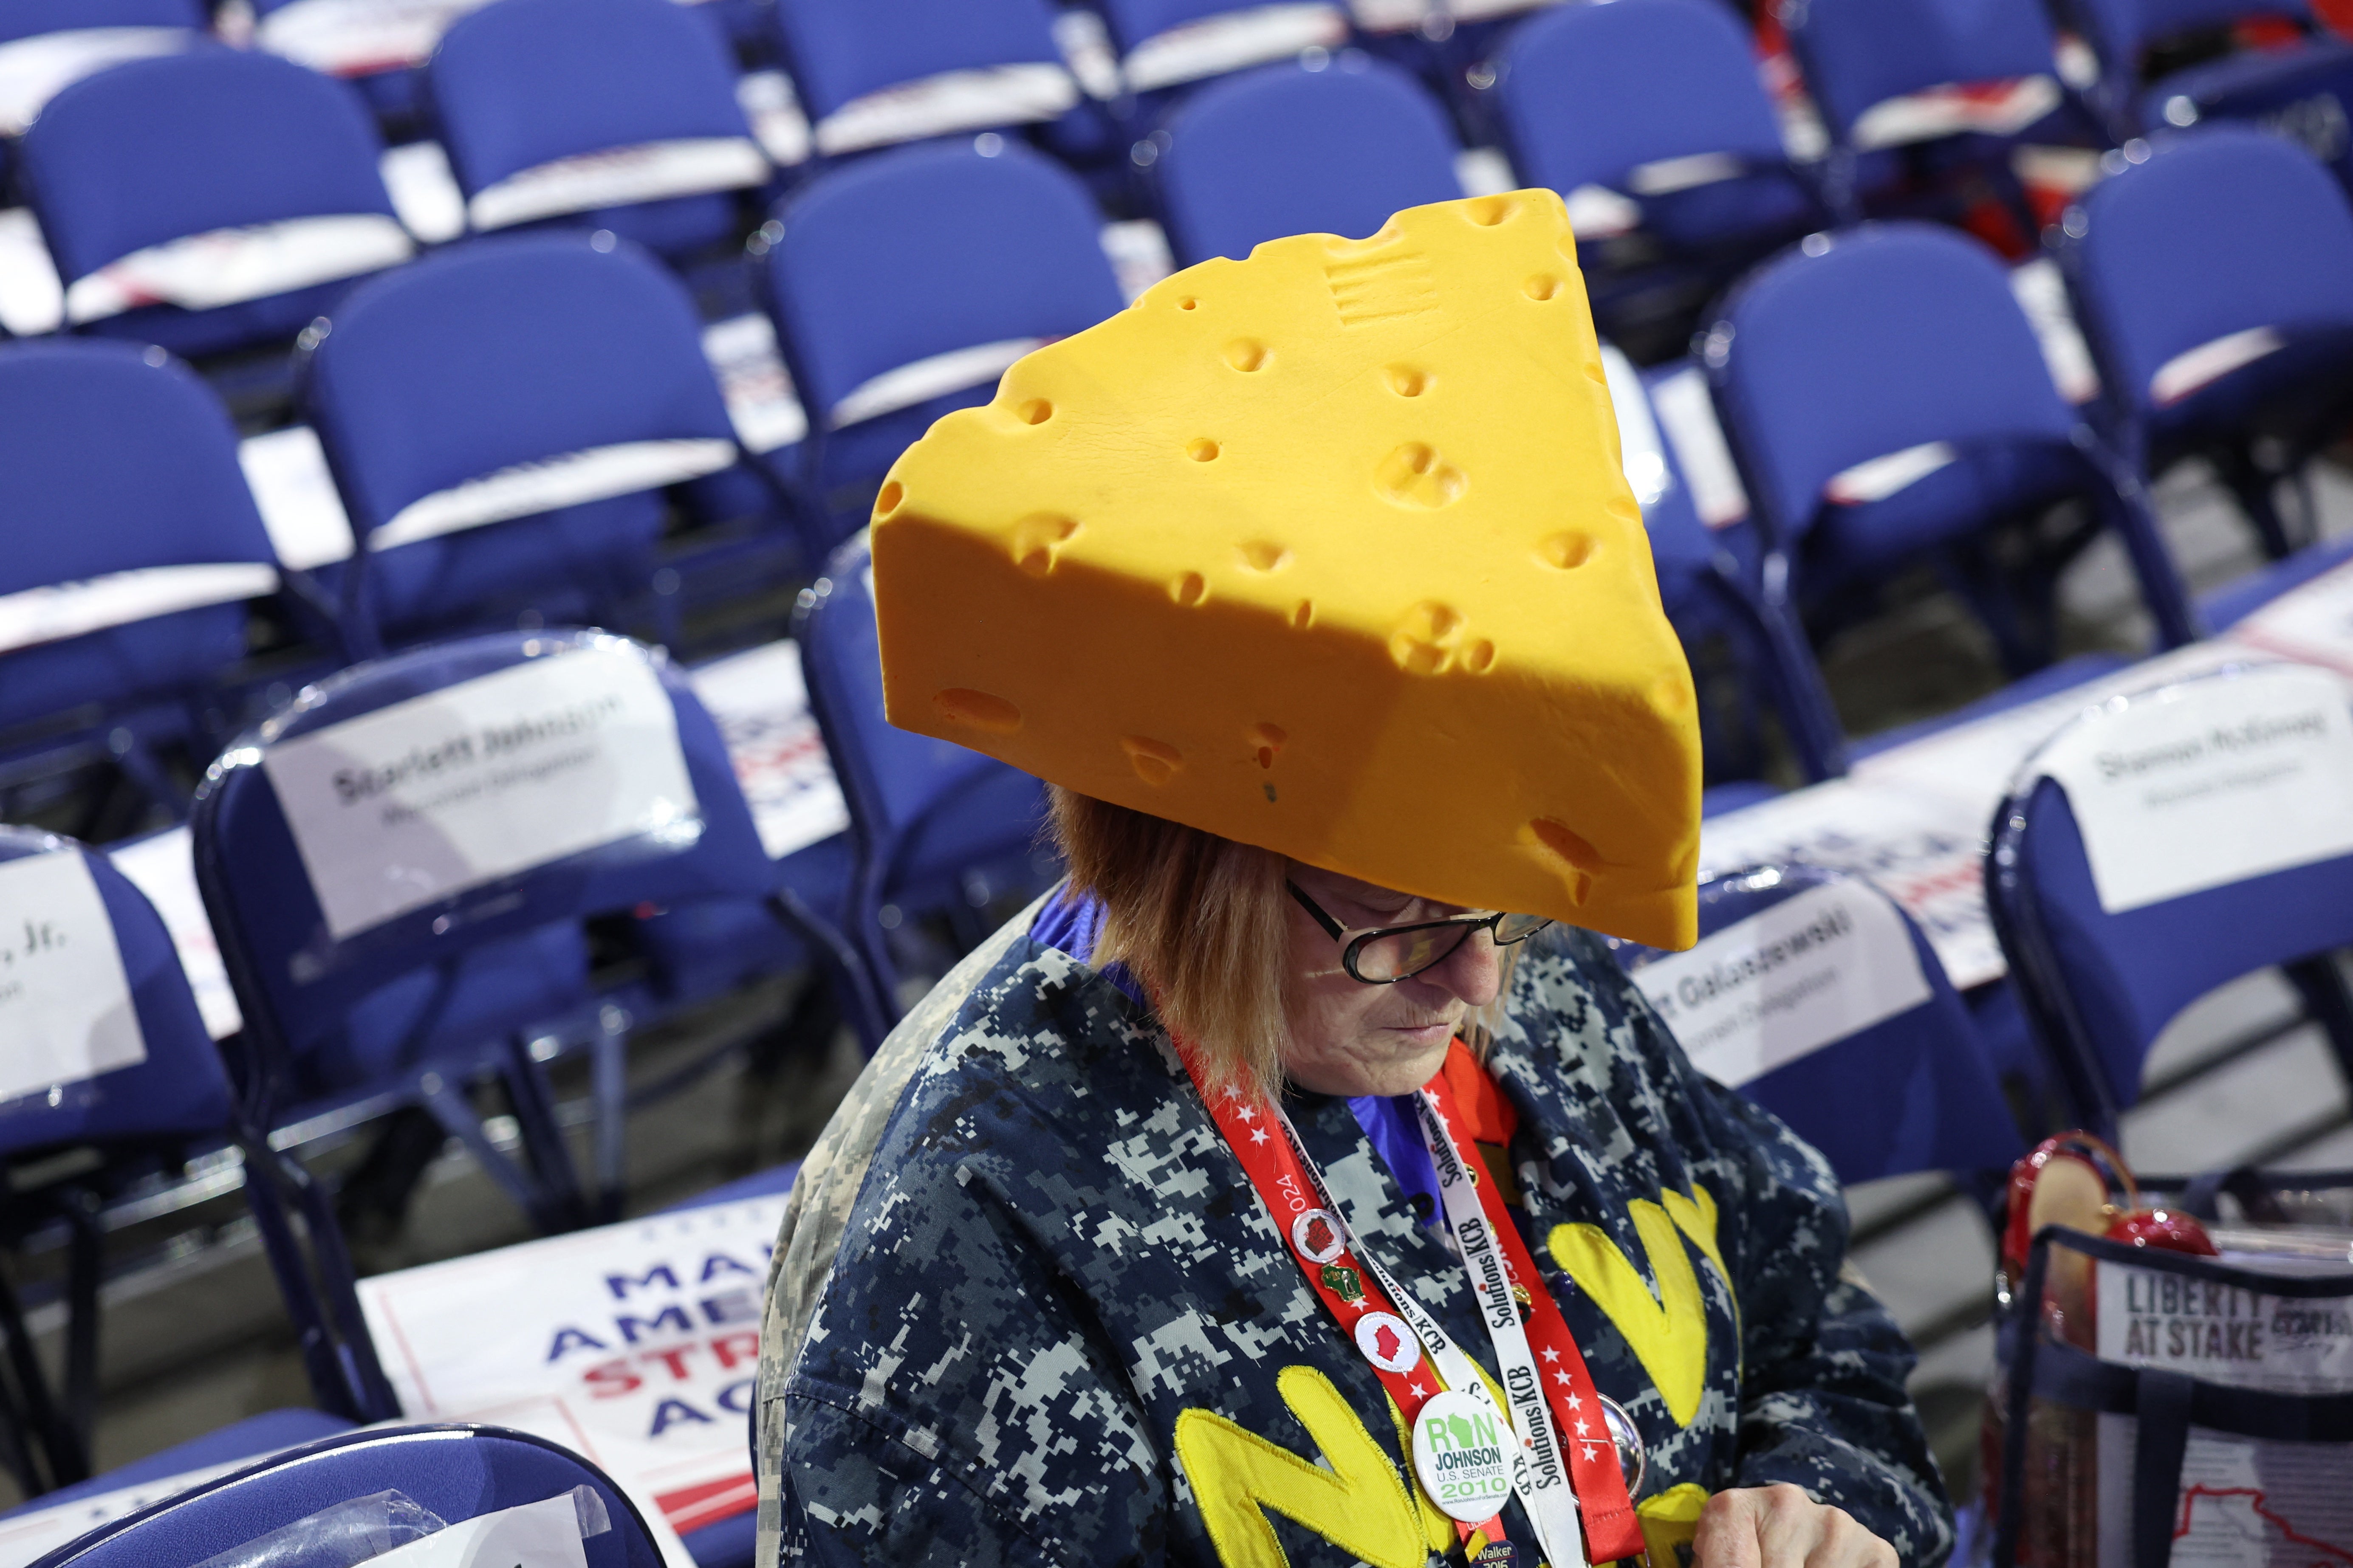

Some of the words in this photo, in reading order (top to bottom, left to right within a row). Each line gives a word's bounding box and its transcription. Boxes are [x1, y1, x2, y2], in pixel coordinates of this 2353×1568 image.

[1276, 1174, 1309, 1216] 024
[1310, 1220, 1334, 1243] RED
[604, 1242, 772, 1300] MA
[2126, 1318, 2161, 1356] AT
[2168, 1319, 2265, 1360] STAKE
[1436, 1447, 1502, 1471] JOHNSON
[1438, 1472, 1460, 1482] U.S.
[1462, 1466, 1504, 1479] SENATE
[1441, 1477, 1506, 1499] 2010
[1442, 1493, 1508, 1505] www.RonJohnsonForSenate.com
[1477, 1546, 1512, 1560] Walker
